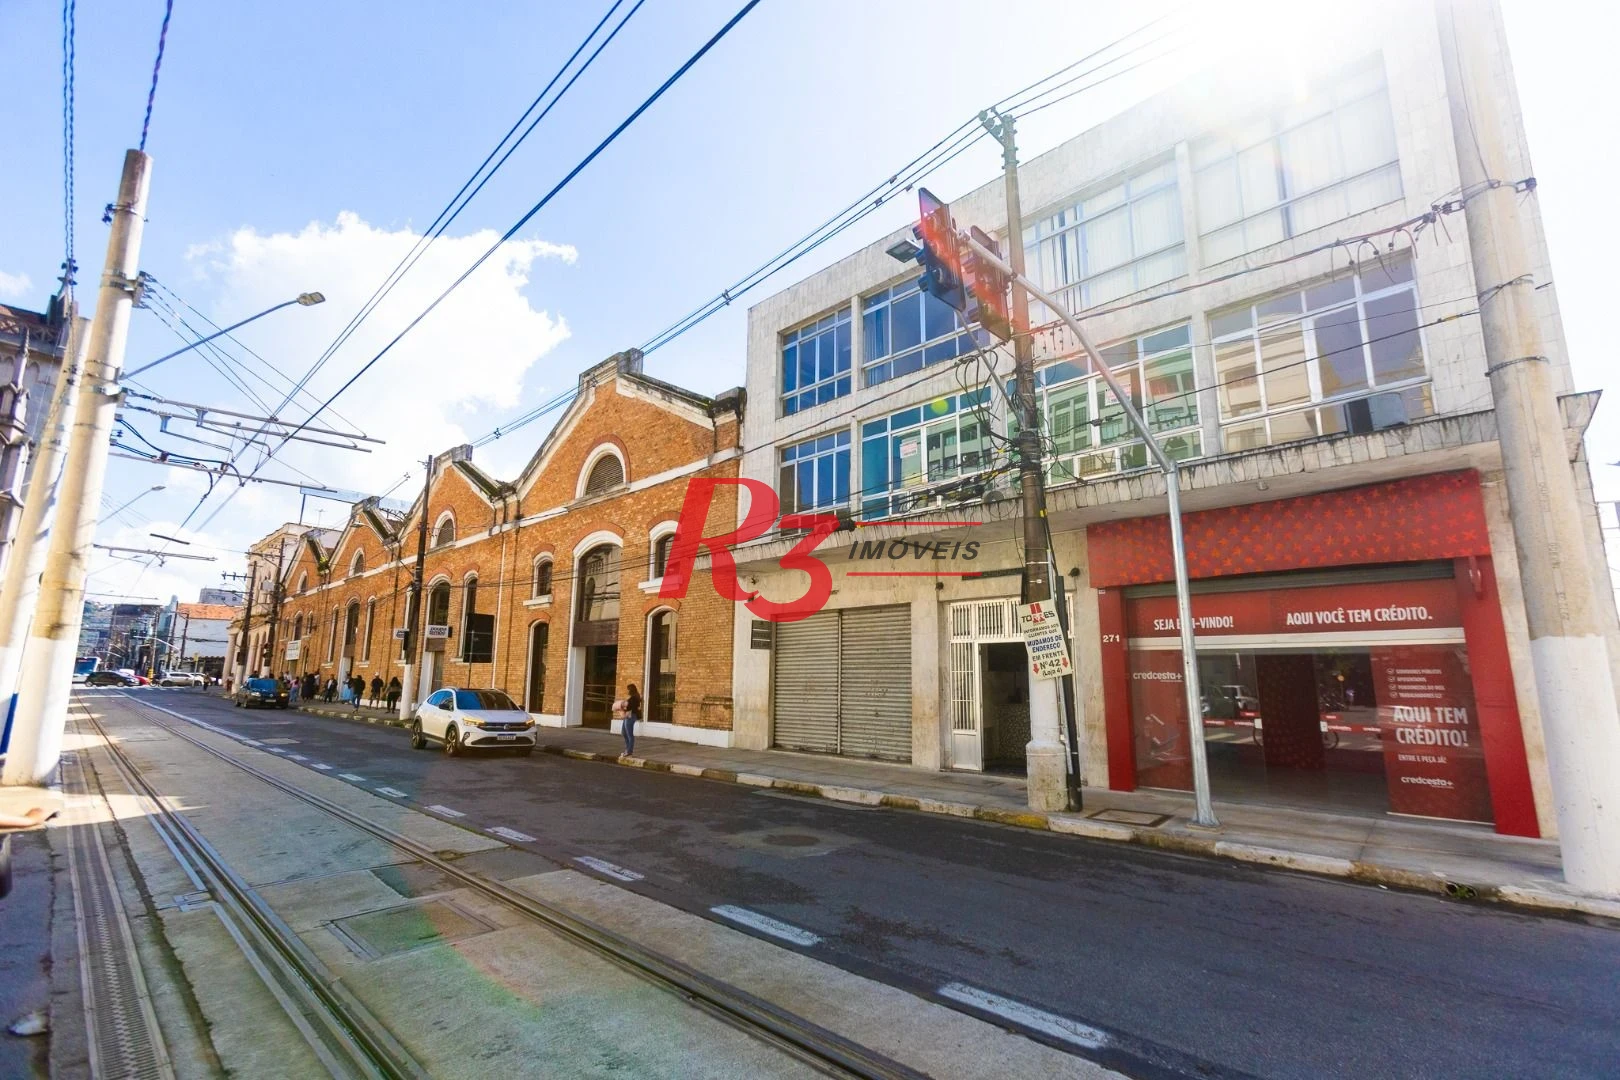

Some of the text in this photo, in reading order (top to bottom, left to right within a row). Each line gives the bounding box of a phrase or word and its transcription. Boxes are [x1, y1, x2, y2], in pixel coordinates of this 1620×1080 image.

[1286, 604, 1433, 626] AQUI VOCÊ TEM CRÉDITO.
[1154, 616, 1234, 631] SEJA -VINDO!
[1027, 636, 1054, 647] MUDAMOS
[1102, 634, 1120, 643] 271
[1042, 650, 1065, 660] FRENTE
[1048, 659, 1061, 667] 42
[1393, 706, 1469, 725] AQUI TEM
[1395, 724, 1469, 747] CRÉDITO!
